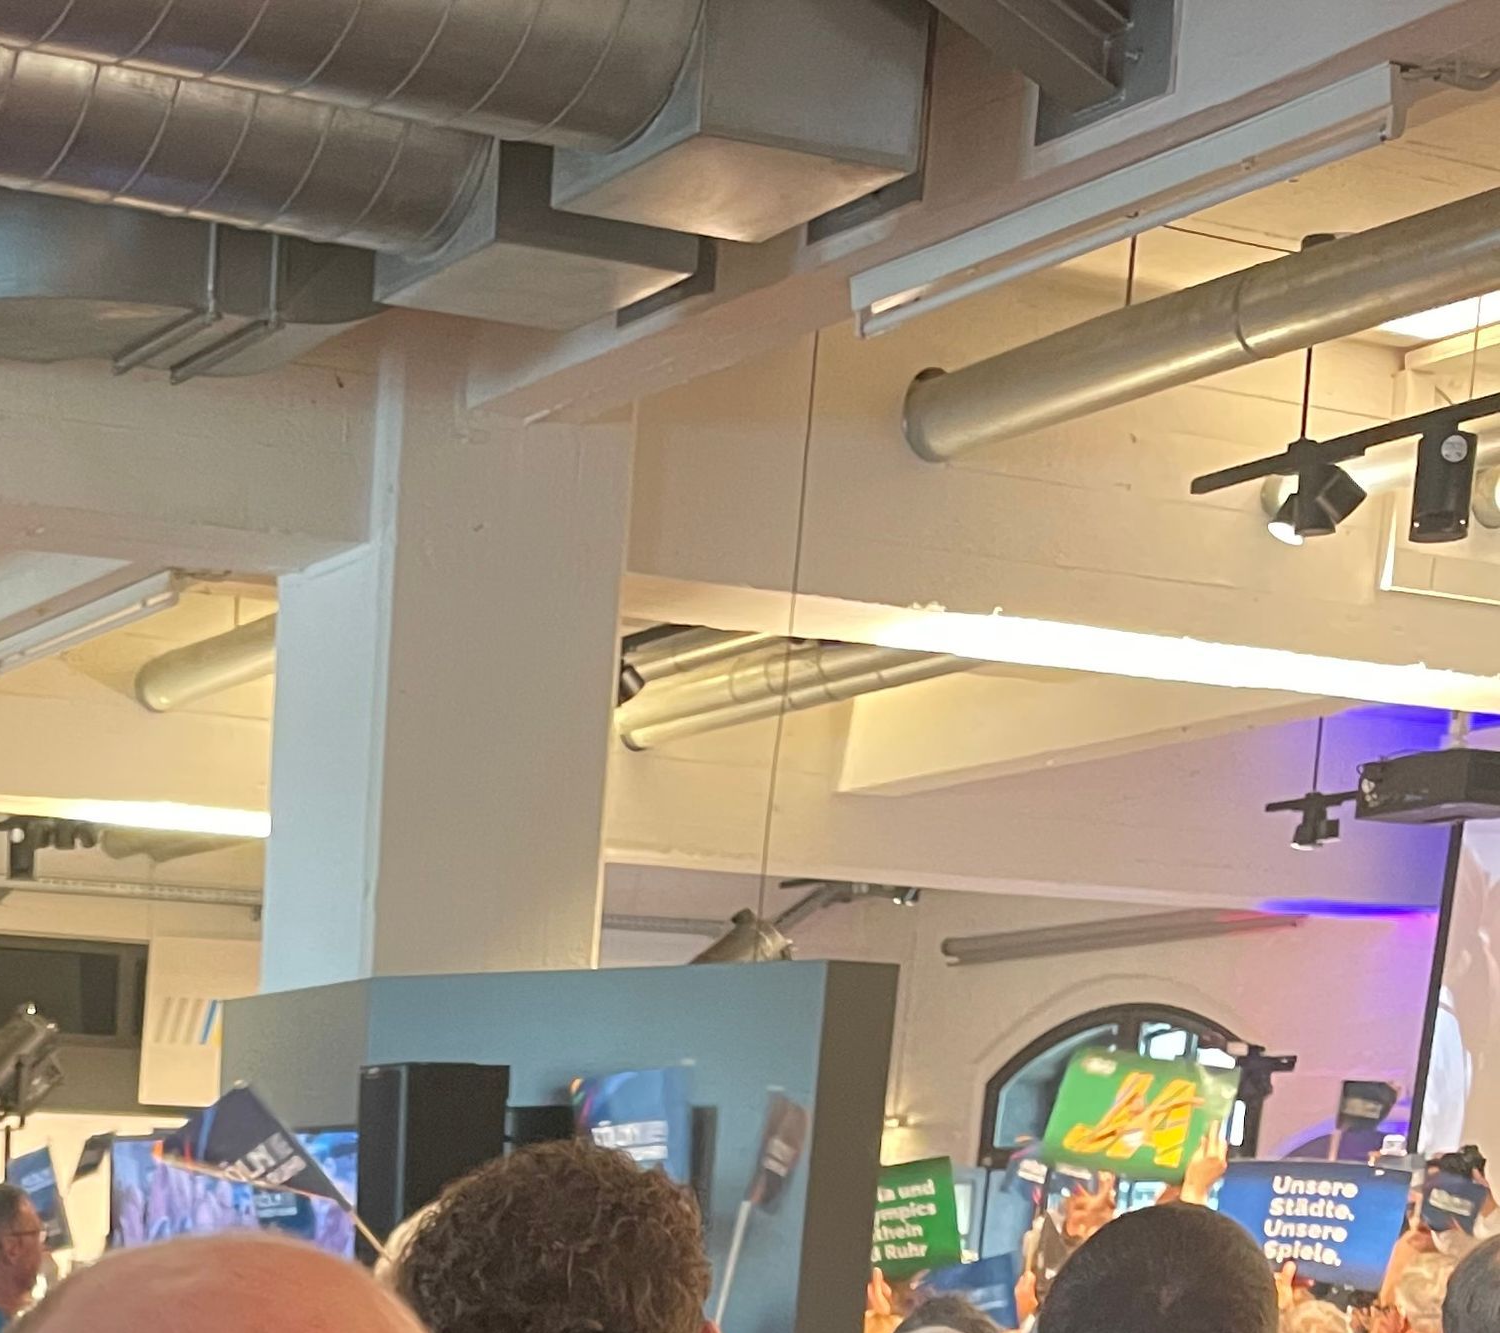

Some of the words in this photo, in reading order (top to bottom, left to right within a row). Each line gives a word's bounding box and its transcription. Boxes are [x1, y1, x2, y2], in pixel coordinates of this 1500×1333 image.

[1271, 1175, 1359, 1199] Unsere
[1268, 1197, 1356, 1222] Städte.
[1263, 1219, 1348, 1243] Unsere
[884, 1241, 928, 1259] Ruhr
[1263, 1240, 1342, 1267] Spiele.
